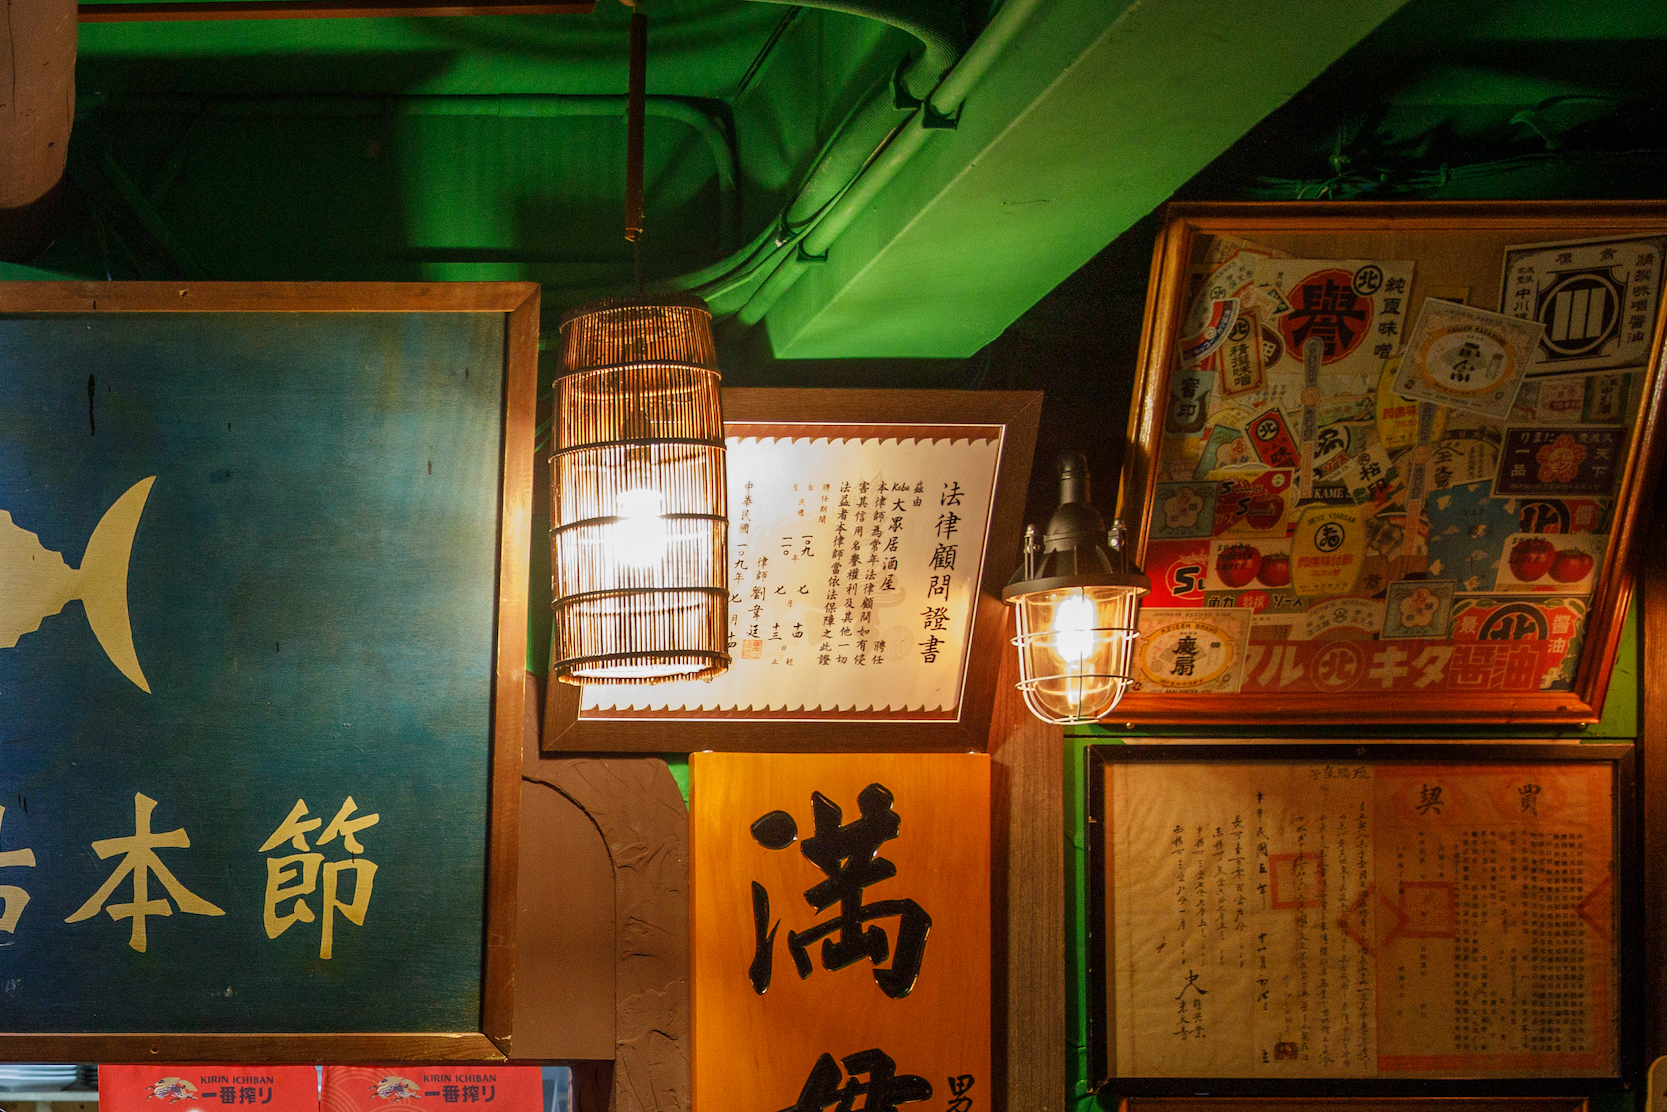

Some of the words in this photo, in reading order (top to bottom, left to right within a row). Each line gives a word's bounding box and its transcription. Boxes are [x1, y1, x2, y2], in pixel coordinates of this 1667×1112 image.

[918, 481, 964, 664] 法律顧問證書
[200, 1075, 229, 1085] KIRIN
[232, 1075, 274, 1085] ICHIBAN
[423, 1073, 451, 1083] KIRIN
[454, 1073, 497, 1083] ICHIBAN
[200, 1086, 273, 1104] 一番搾り
[424, 1084, 496, 1103] 一番搾り
